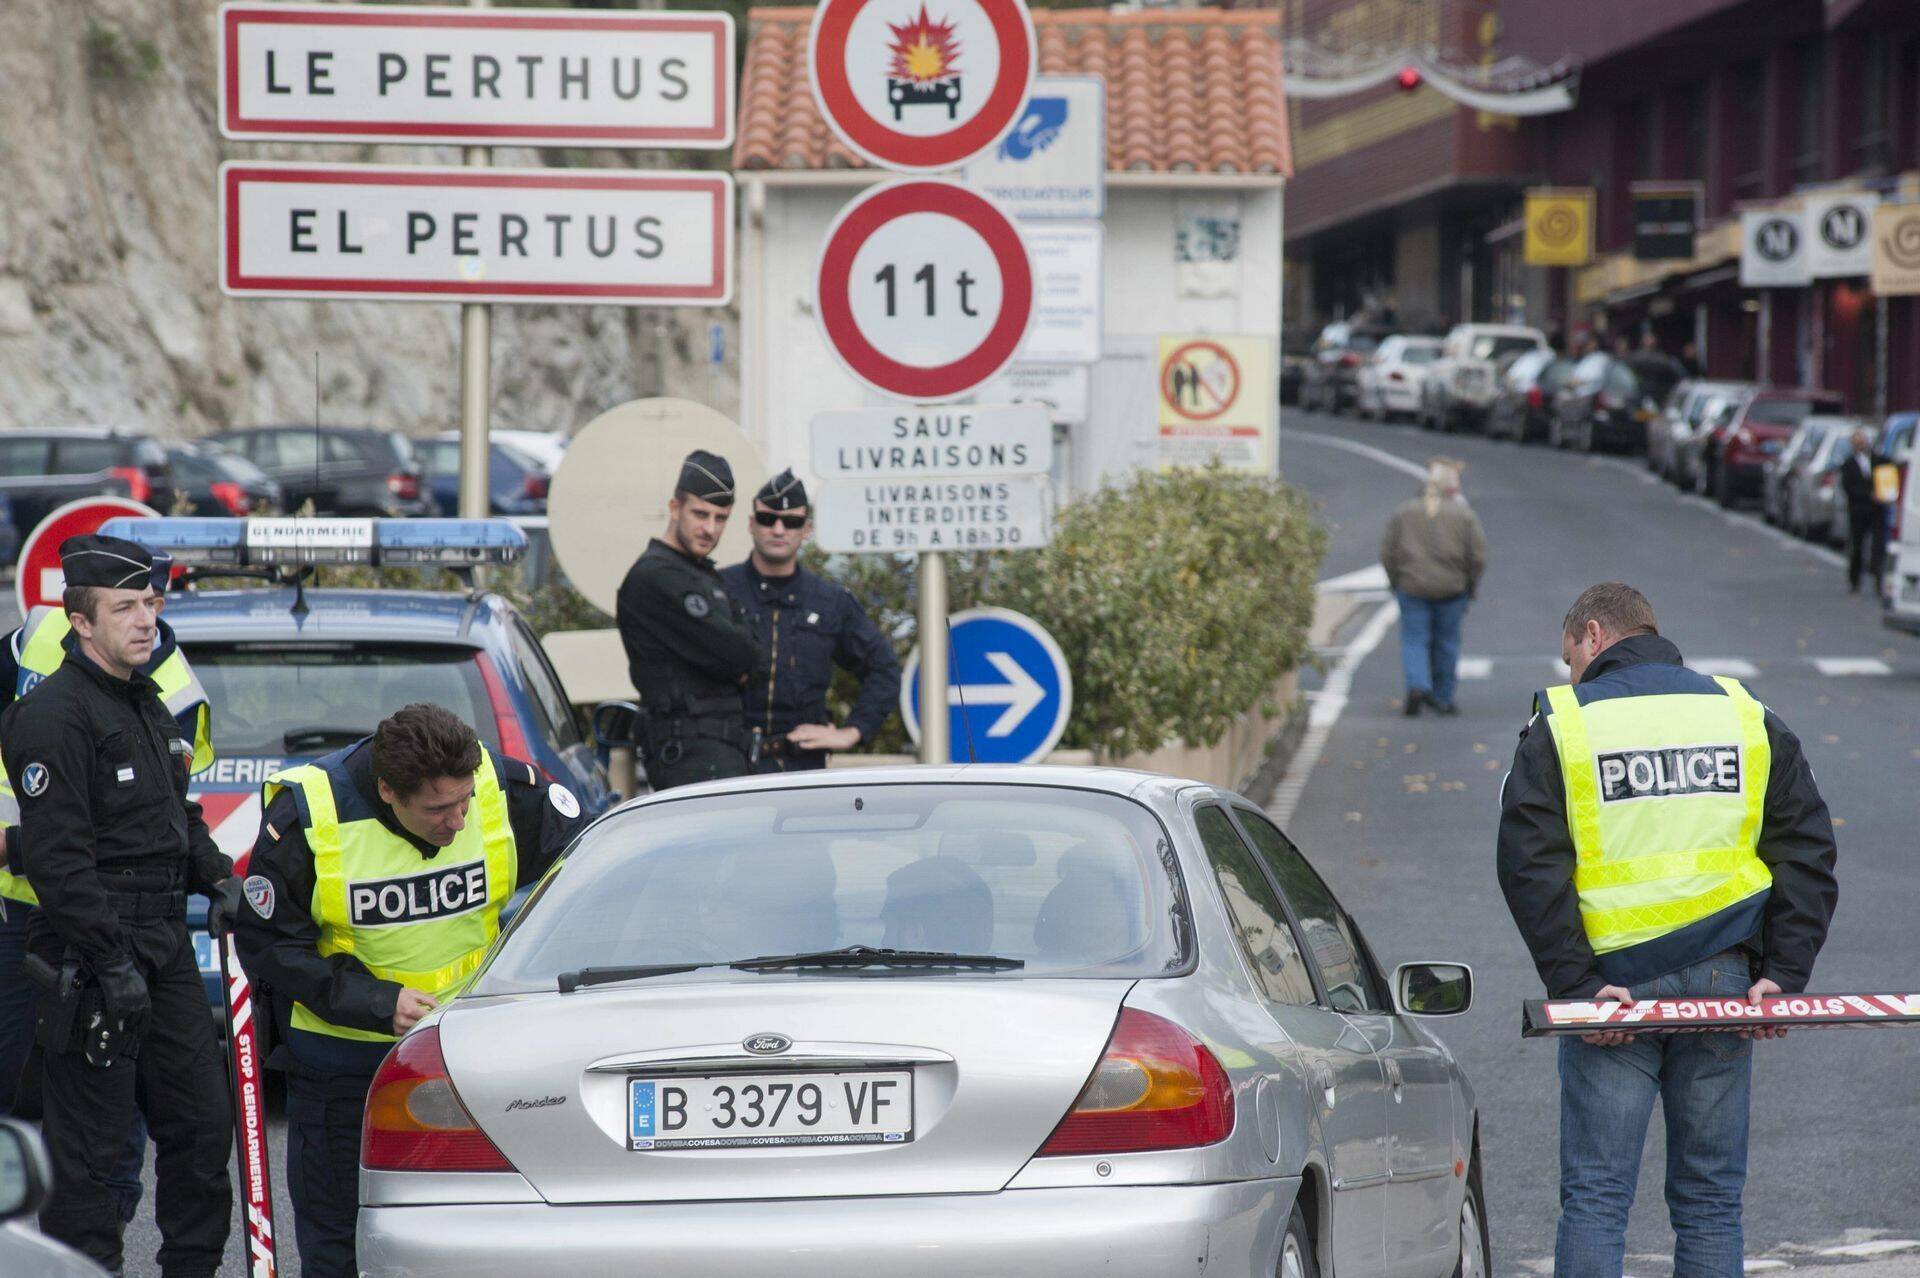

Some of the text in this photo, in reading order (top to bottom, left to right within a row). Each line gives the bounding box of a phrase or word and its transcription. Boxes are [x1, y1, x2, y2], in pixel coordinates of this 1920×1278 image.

[266, 50, 689, 101] LE PERTHUS
[290, 209, 664, 260] EL PERTUS
[894, 415, 973, 439] SAUF
[838, 444, 1028, 470] LIVRAISONS
[865, 483, 1010, 503] LIVRAISONS
[868, 505, 1009, 525] INTERDITES
[253, 527, 366, 536] GENDARMERIE
[853, 529, 881, 546] DE
[893, 529, 919, 546] 9h
[929, 529, 942, 545] A
[1601, 751, 1738, 796] POLICE
[353, 866, 485, 921] POLICE
[1658, 1000, 1763, 1019] POLICE
[1771, 998, 1846, 1016] STOP
[753, 1037, 780, 1050] Ford
[239, 1034, 253, 1078] STOP
[505, 1095, 567, 1112] Mondeo
[662, 1080, 898, 1131] B 3379 VF
[639, 1114, 650, 1128] E
[243, 1082, 264, 1203] GENDARMERIE
